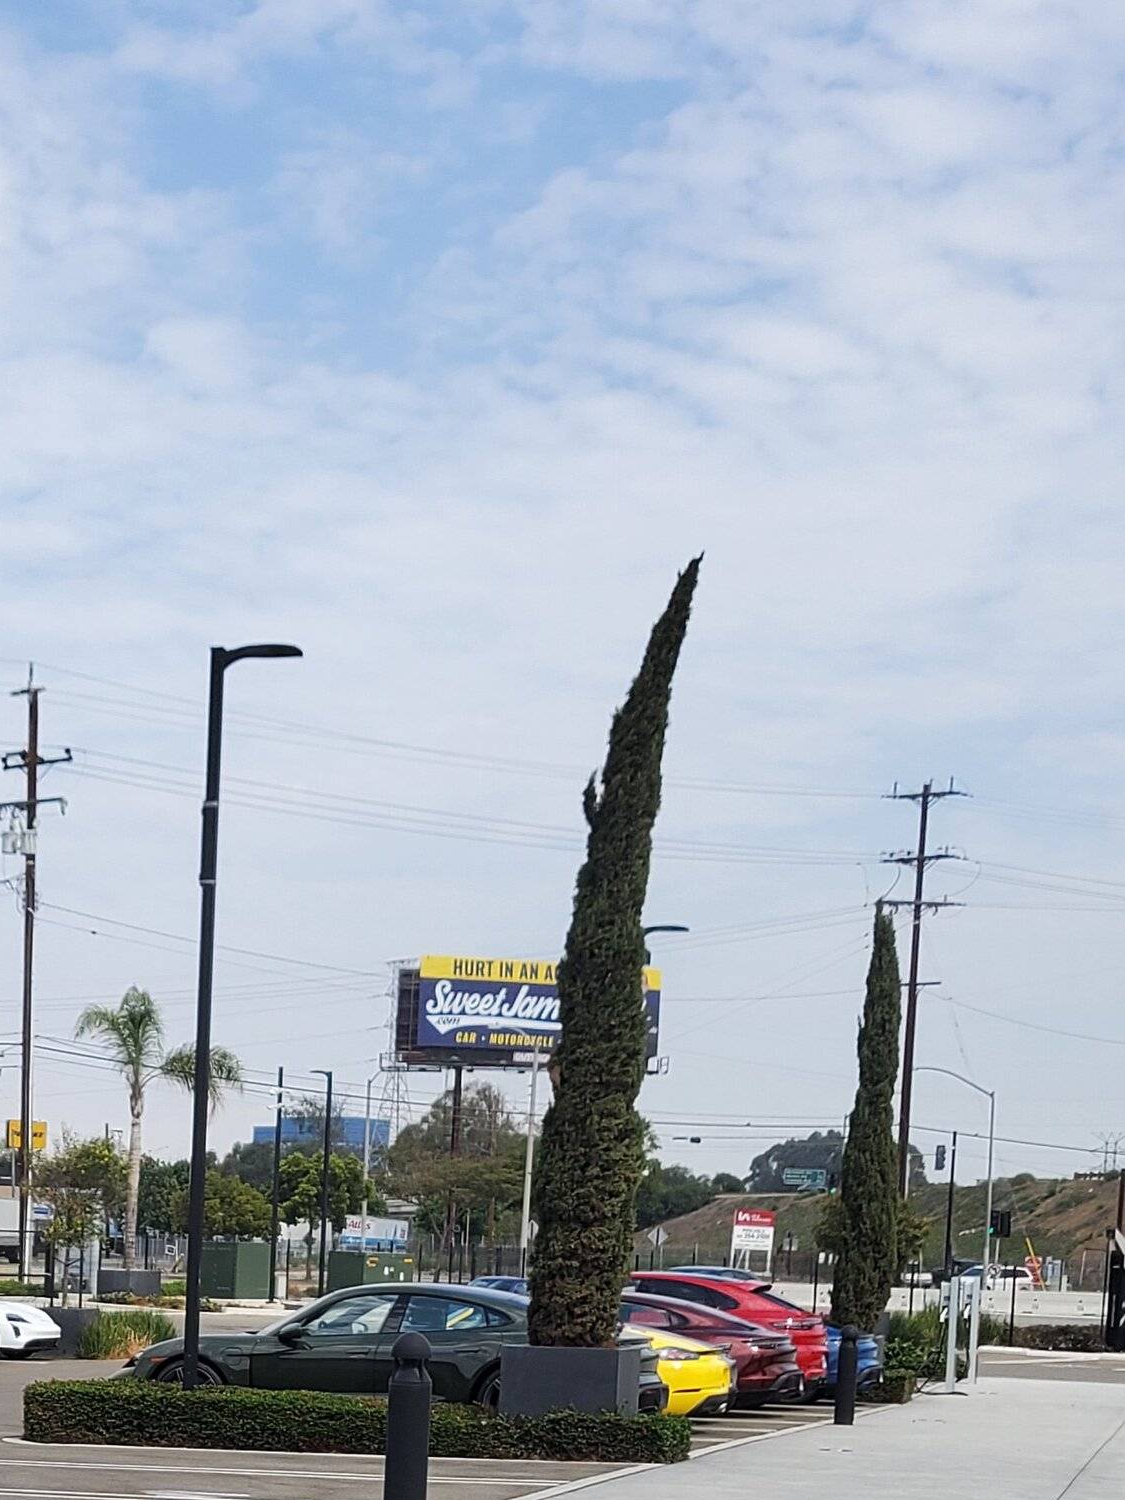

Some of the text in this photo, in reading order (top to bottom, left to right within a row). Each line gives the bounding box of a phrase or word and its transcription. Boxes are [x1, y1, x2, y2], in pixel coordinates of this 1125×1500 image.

[453, 958, 493, 977] HURT
[500, 961, 513, 978] IN
[520, 962, 539, 980] AN
[456, 1031, 554, 1047] CAR MOTORCYCLE
